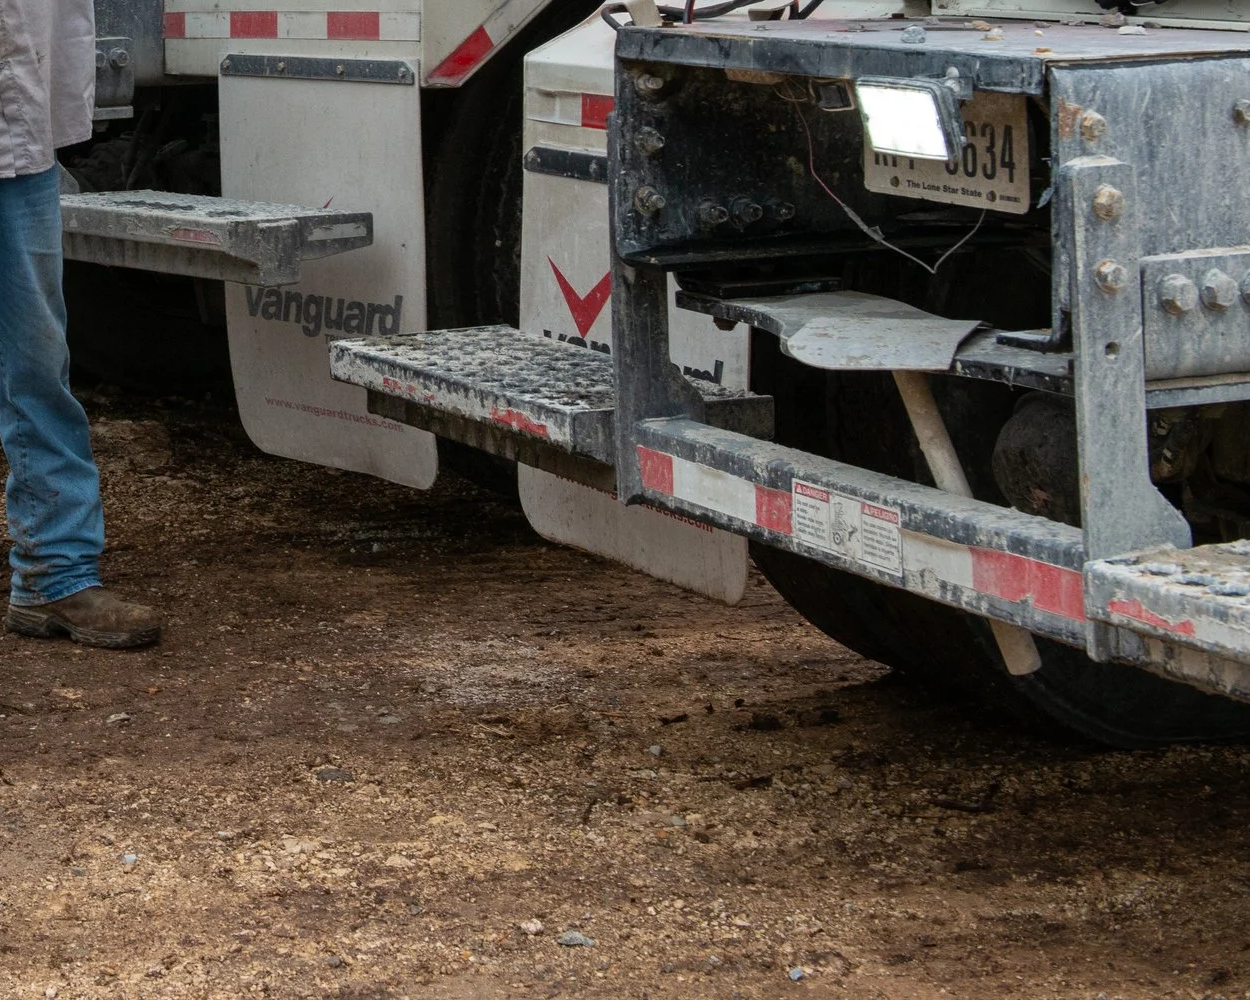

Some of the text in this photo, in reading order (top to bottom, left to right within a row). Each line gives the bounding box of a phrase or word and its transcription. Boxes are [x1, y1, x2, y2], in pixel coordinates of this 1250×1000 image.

[906, 179, 981, 197] The Lone Star State
[245, 285, 403, 337] vanguard
[265, 396, 404, 432] www.vanguardtrucks.com
[802, 485, 827, 501] DANGER
[870, 506, 897, 523] PELIGRO
